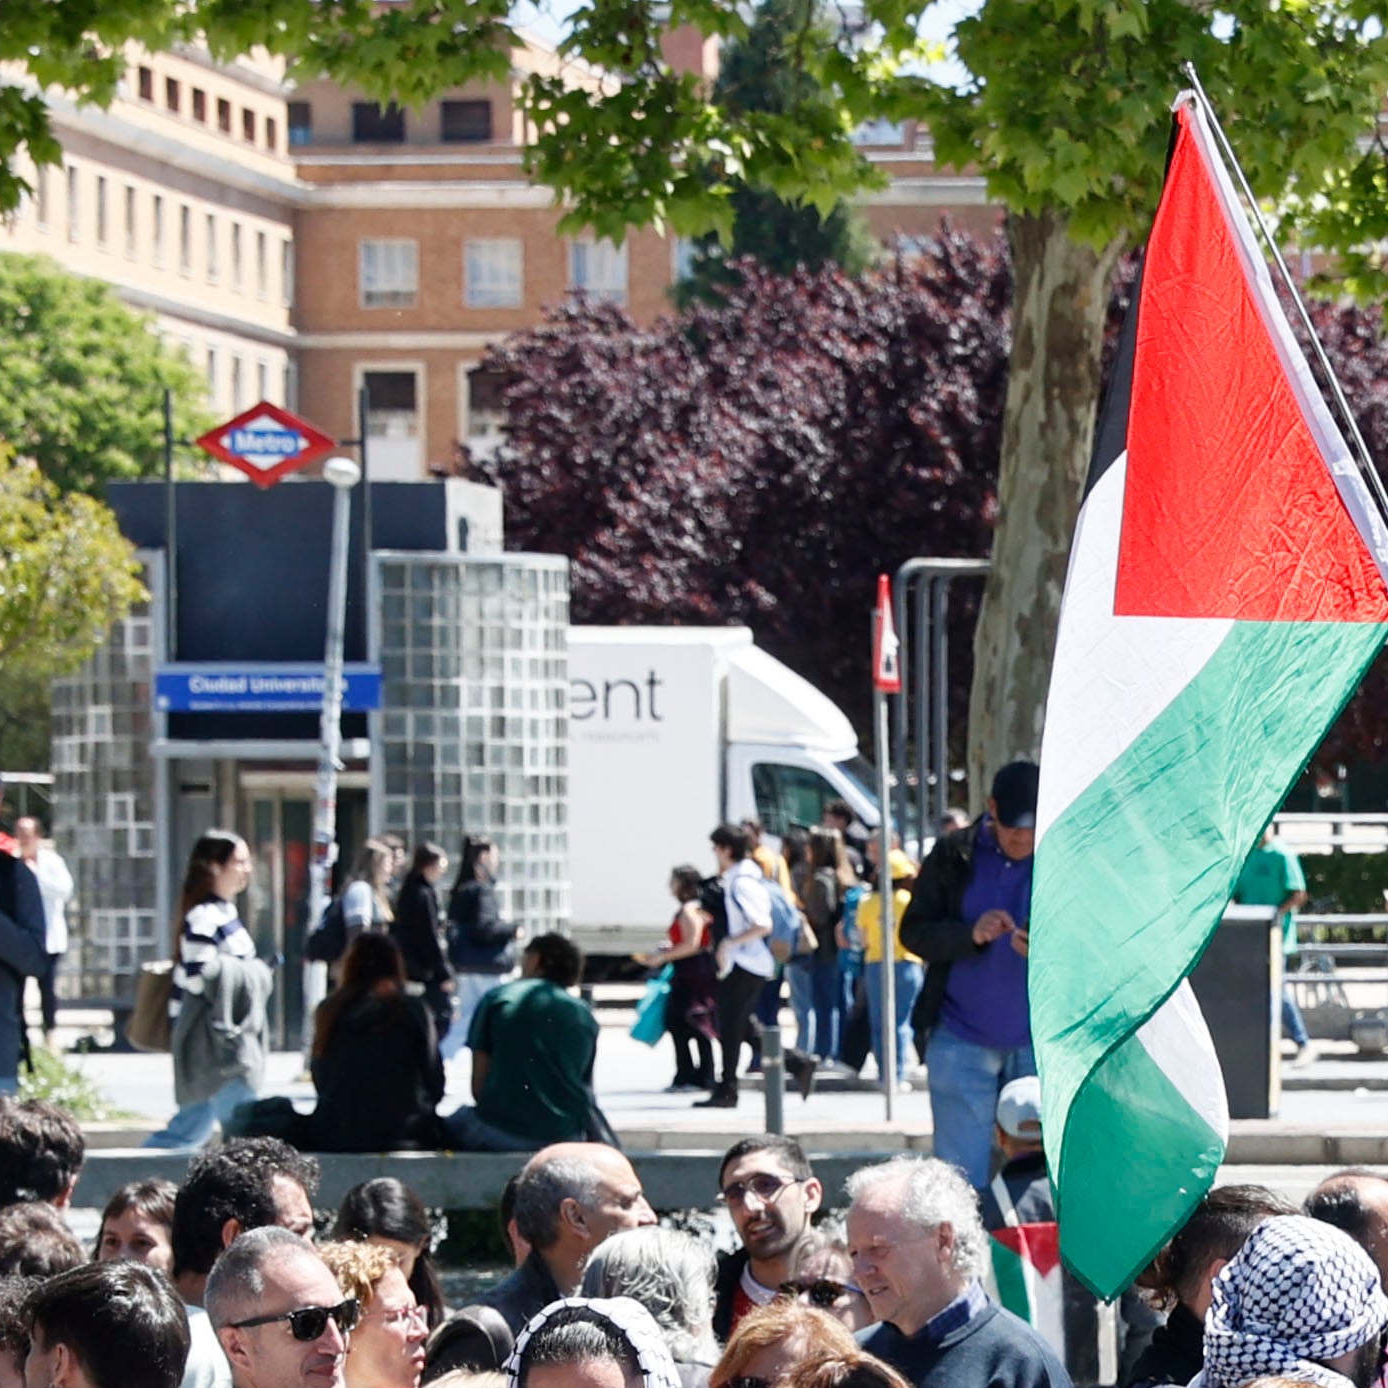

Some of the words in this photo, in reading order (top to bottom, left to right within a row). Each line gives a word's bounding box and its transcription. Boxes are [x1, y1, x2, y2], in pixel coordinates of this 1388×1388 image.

[234, 430, 296, 453] Metro
[188, 674, 248, 694] Ciudad
[570, 668, 664, 722] ent
